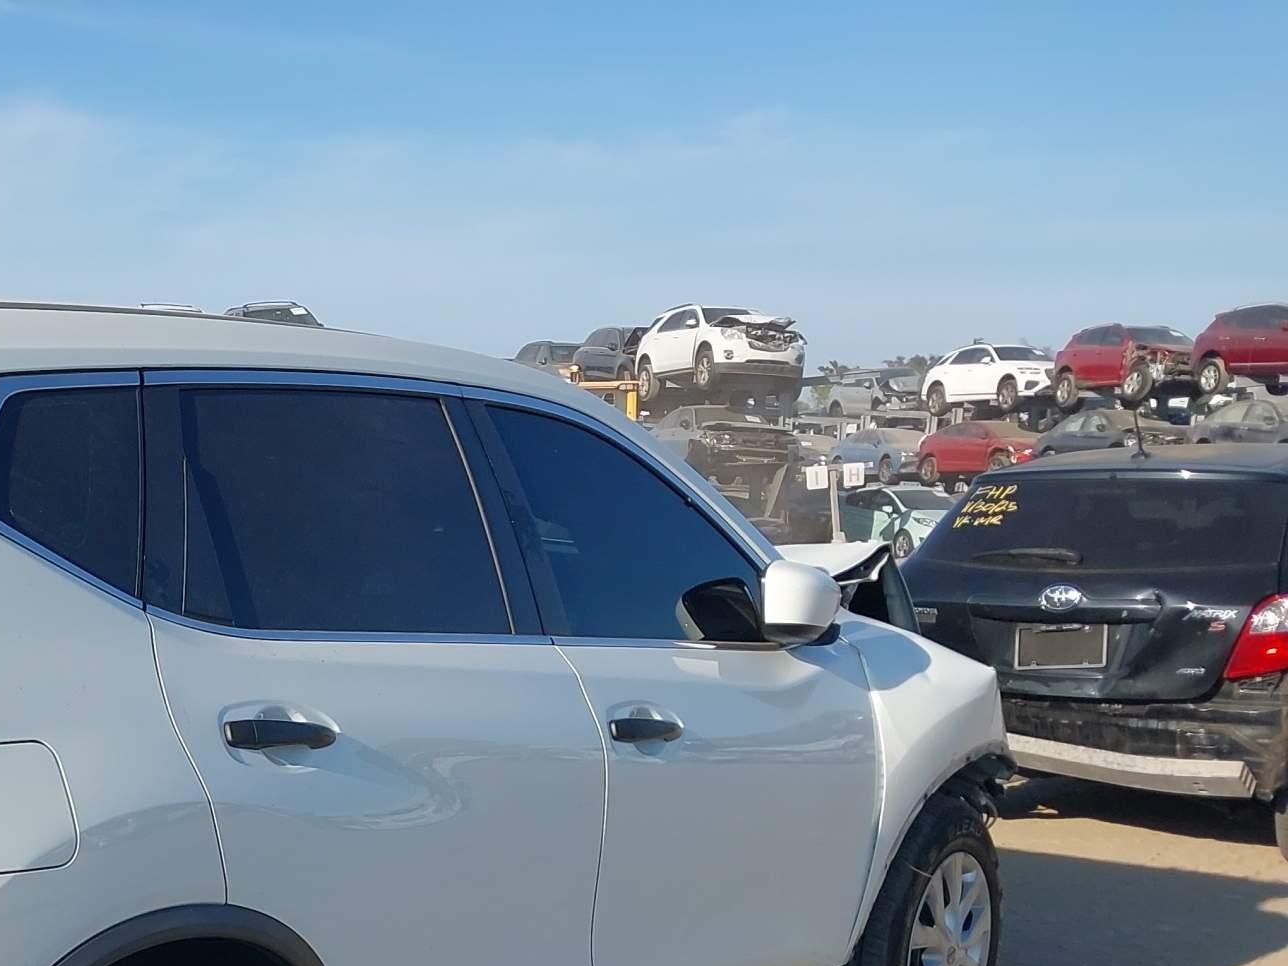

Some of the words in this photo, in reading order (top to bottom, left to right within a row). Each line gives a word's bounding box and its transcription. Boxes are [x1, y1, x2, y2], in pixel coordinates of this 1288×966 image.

[970, 485, 1018, 499] FHP
[1181, 608, 1239, 620] MATRIX
[1208, 621, 1225, 631] S
